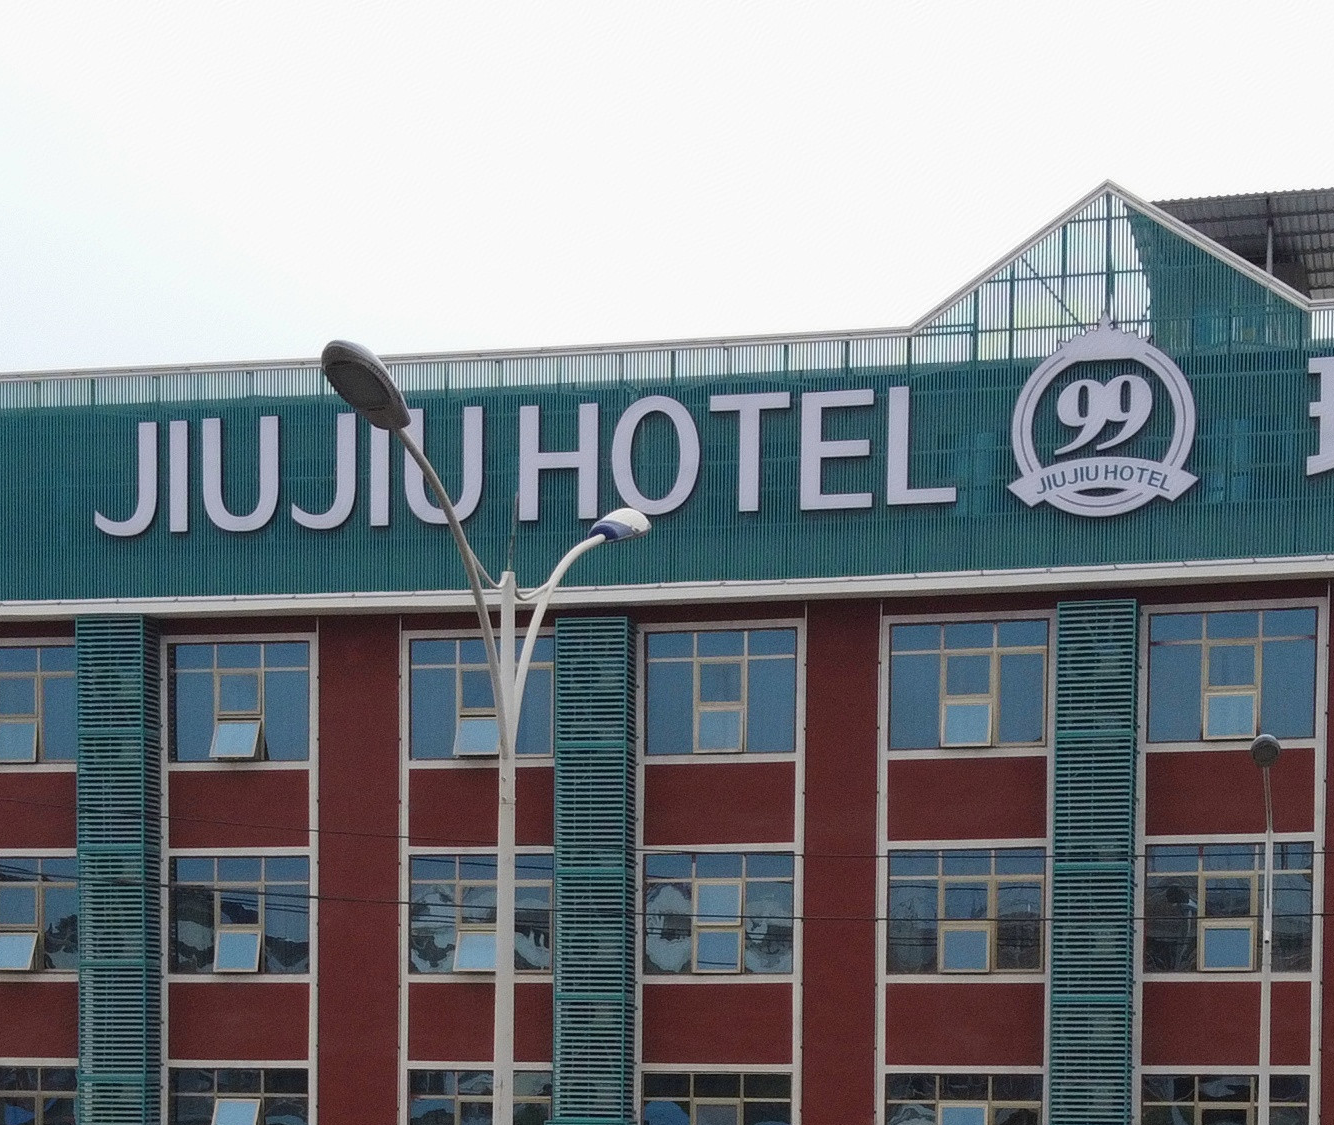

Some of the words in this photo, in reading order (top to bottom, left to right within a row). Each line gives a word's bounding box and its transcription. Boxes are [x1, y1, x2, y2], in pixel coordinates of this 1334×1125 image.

[518, 386, 957, 523] HOTEL
[1054, 374, 1153, 456] 99
[1036, 464, 1099, 495] JIUJIU
[1103, 464, 1171, 493] HOTEL
